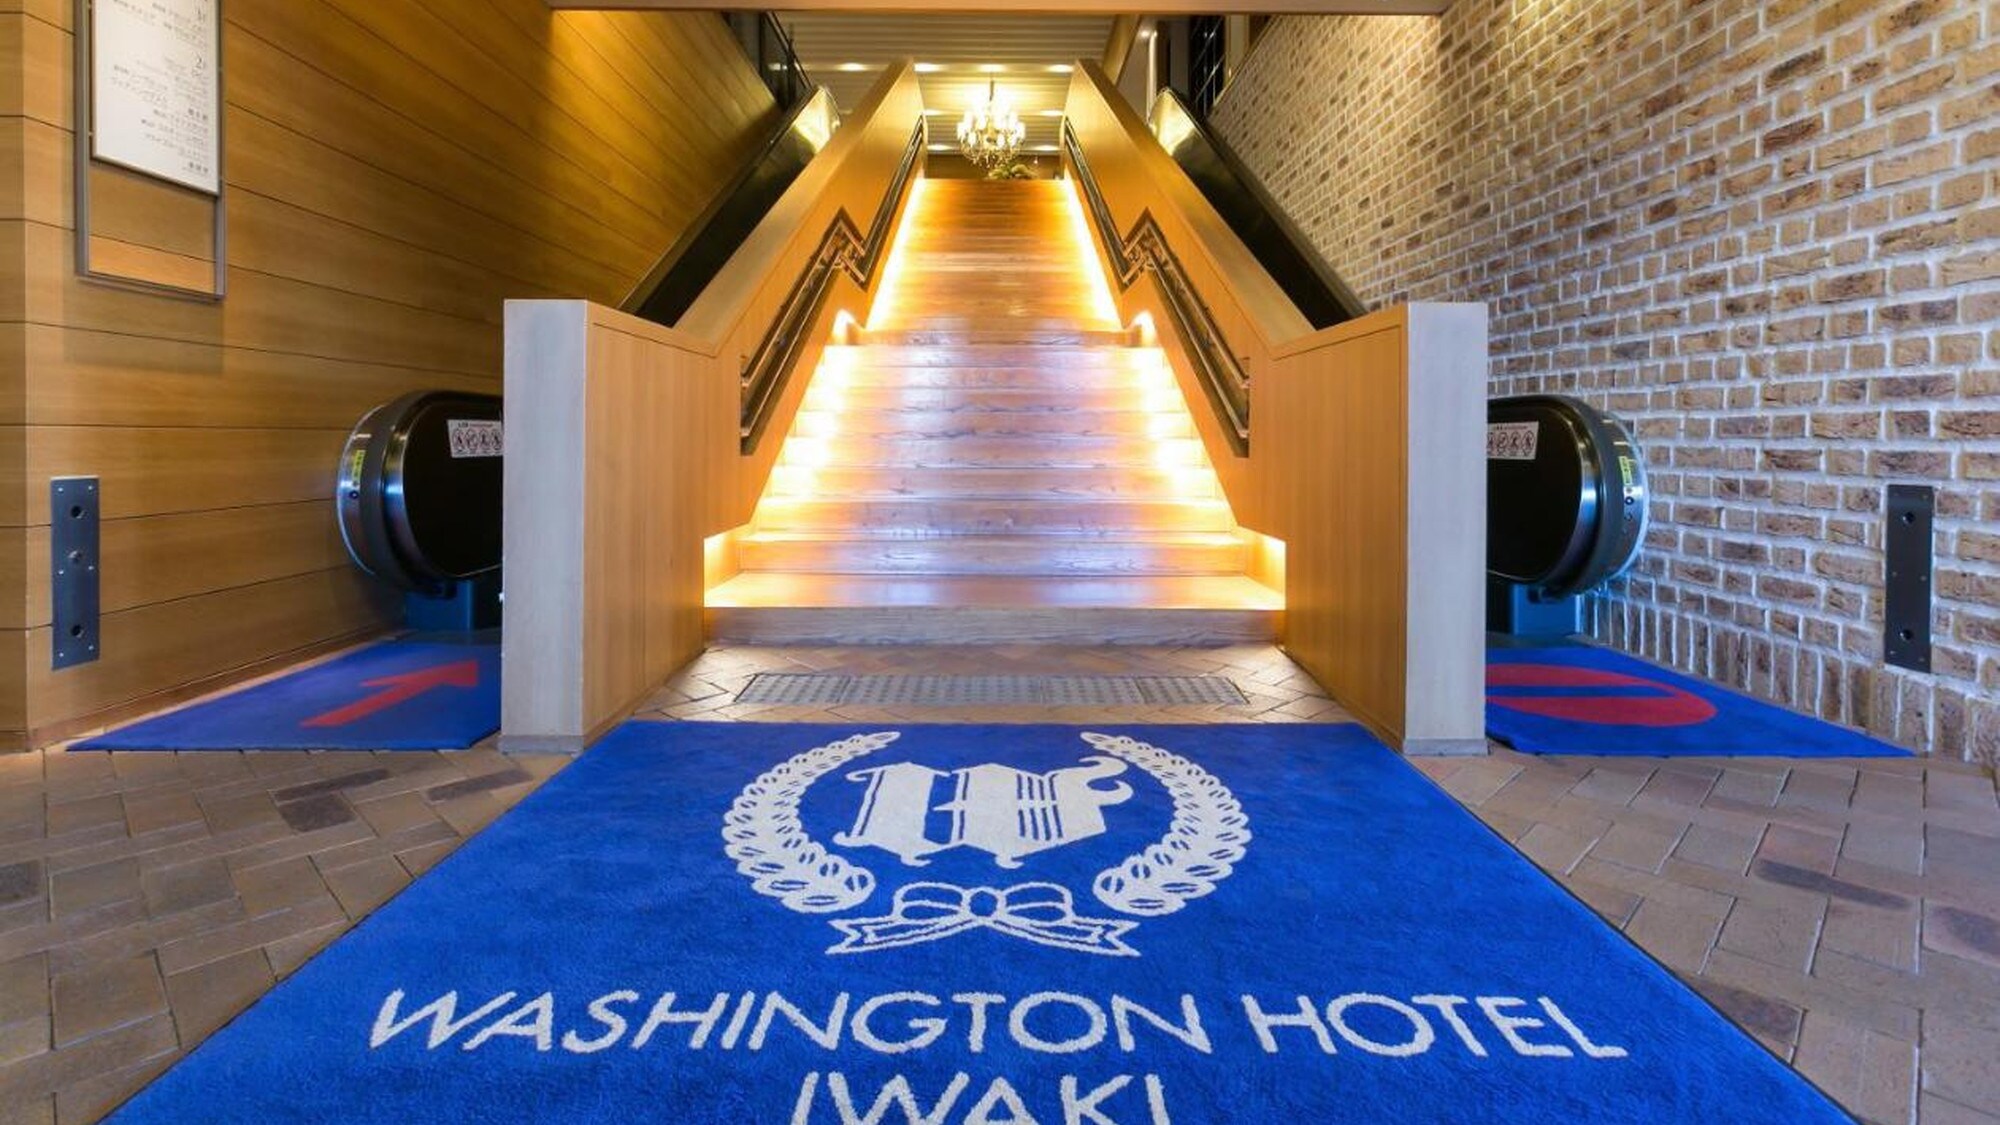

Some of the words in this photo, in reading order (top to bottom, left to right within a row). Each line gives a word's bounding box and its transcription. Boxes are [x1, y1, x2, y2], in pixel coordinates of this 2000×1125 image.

[369, 989, 1212, 1054] WASHINGTON
[1241, 992, 1628, 1059] HOTEL
[791, 1071, 1170, 1125] IWAKI
